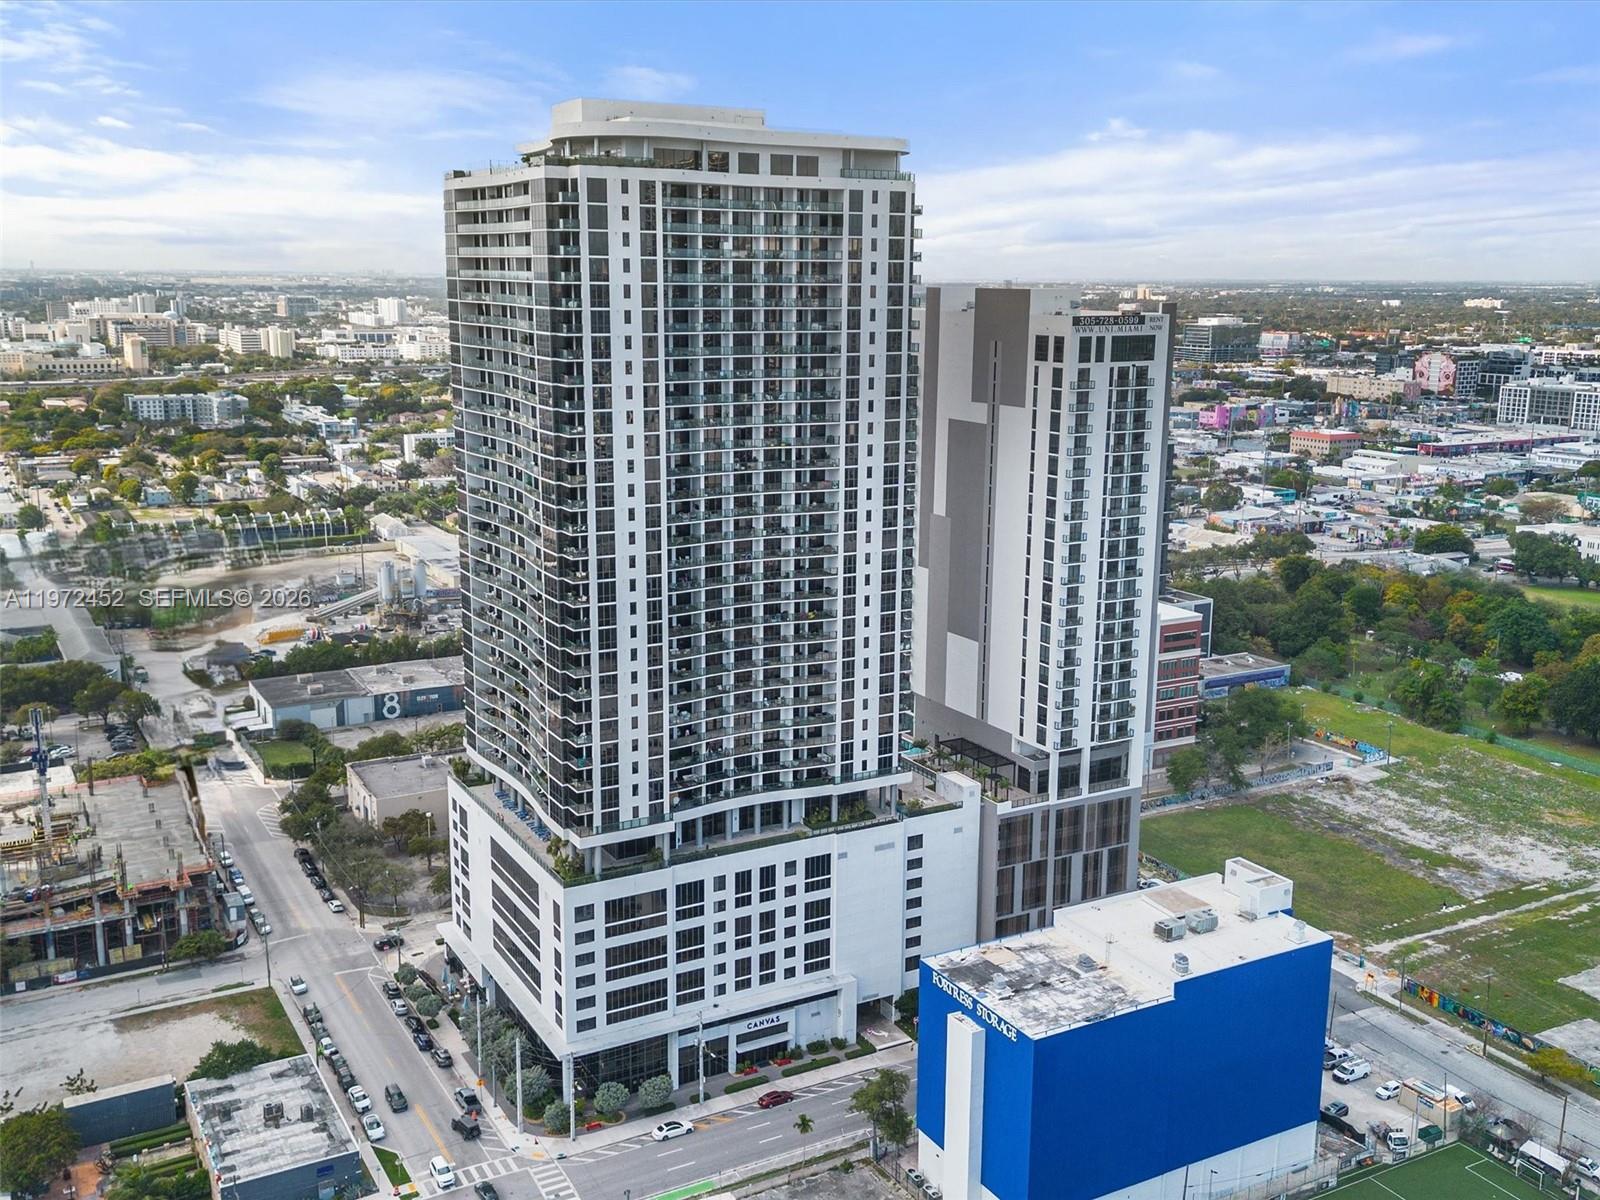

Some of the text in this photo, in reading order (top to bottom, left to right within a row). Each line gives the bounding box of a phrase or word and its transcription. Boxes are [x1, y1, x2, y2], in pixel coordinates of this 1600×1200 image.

[1079, 316, 1139, 326] 305-728-0599
[1074, 325, 1143, 334] WWW.UNI.MIAMI
[382, 692, 401, 719] 8
[932, 970, 1018, 1042] FORTRESS STORAGE
[746, 1015, 781, 1030] CANVAS
